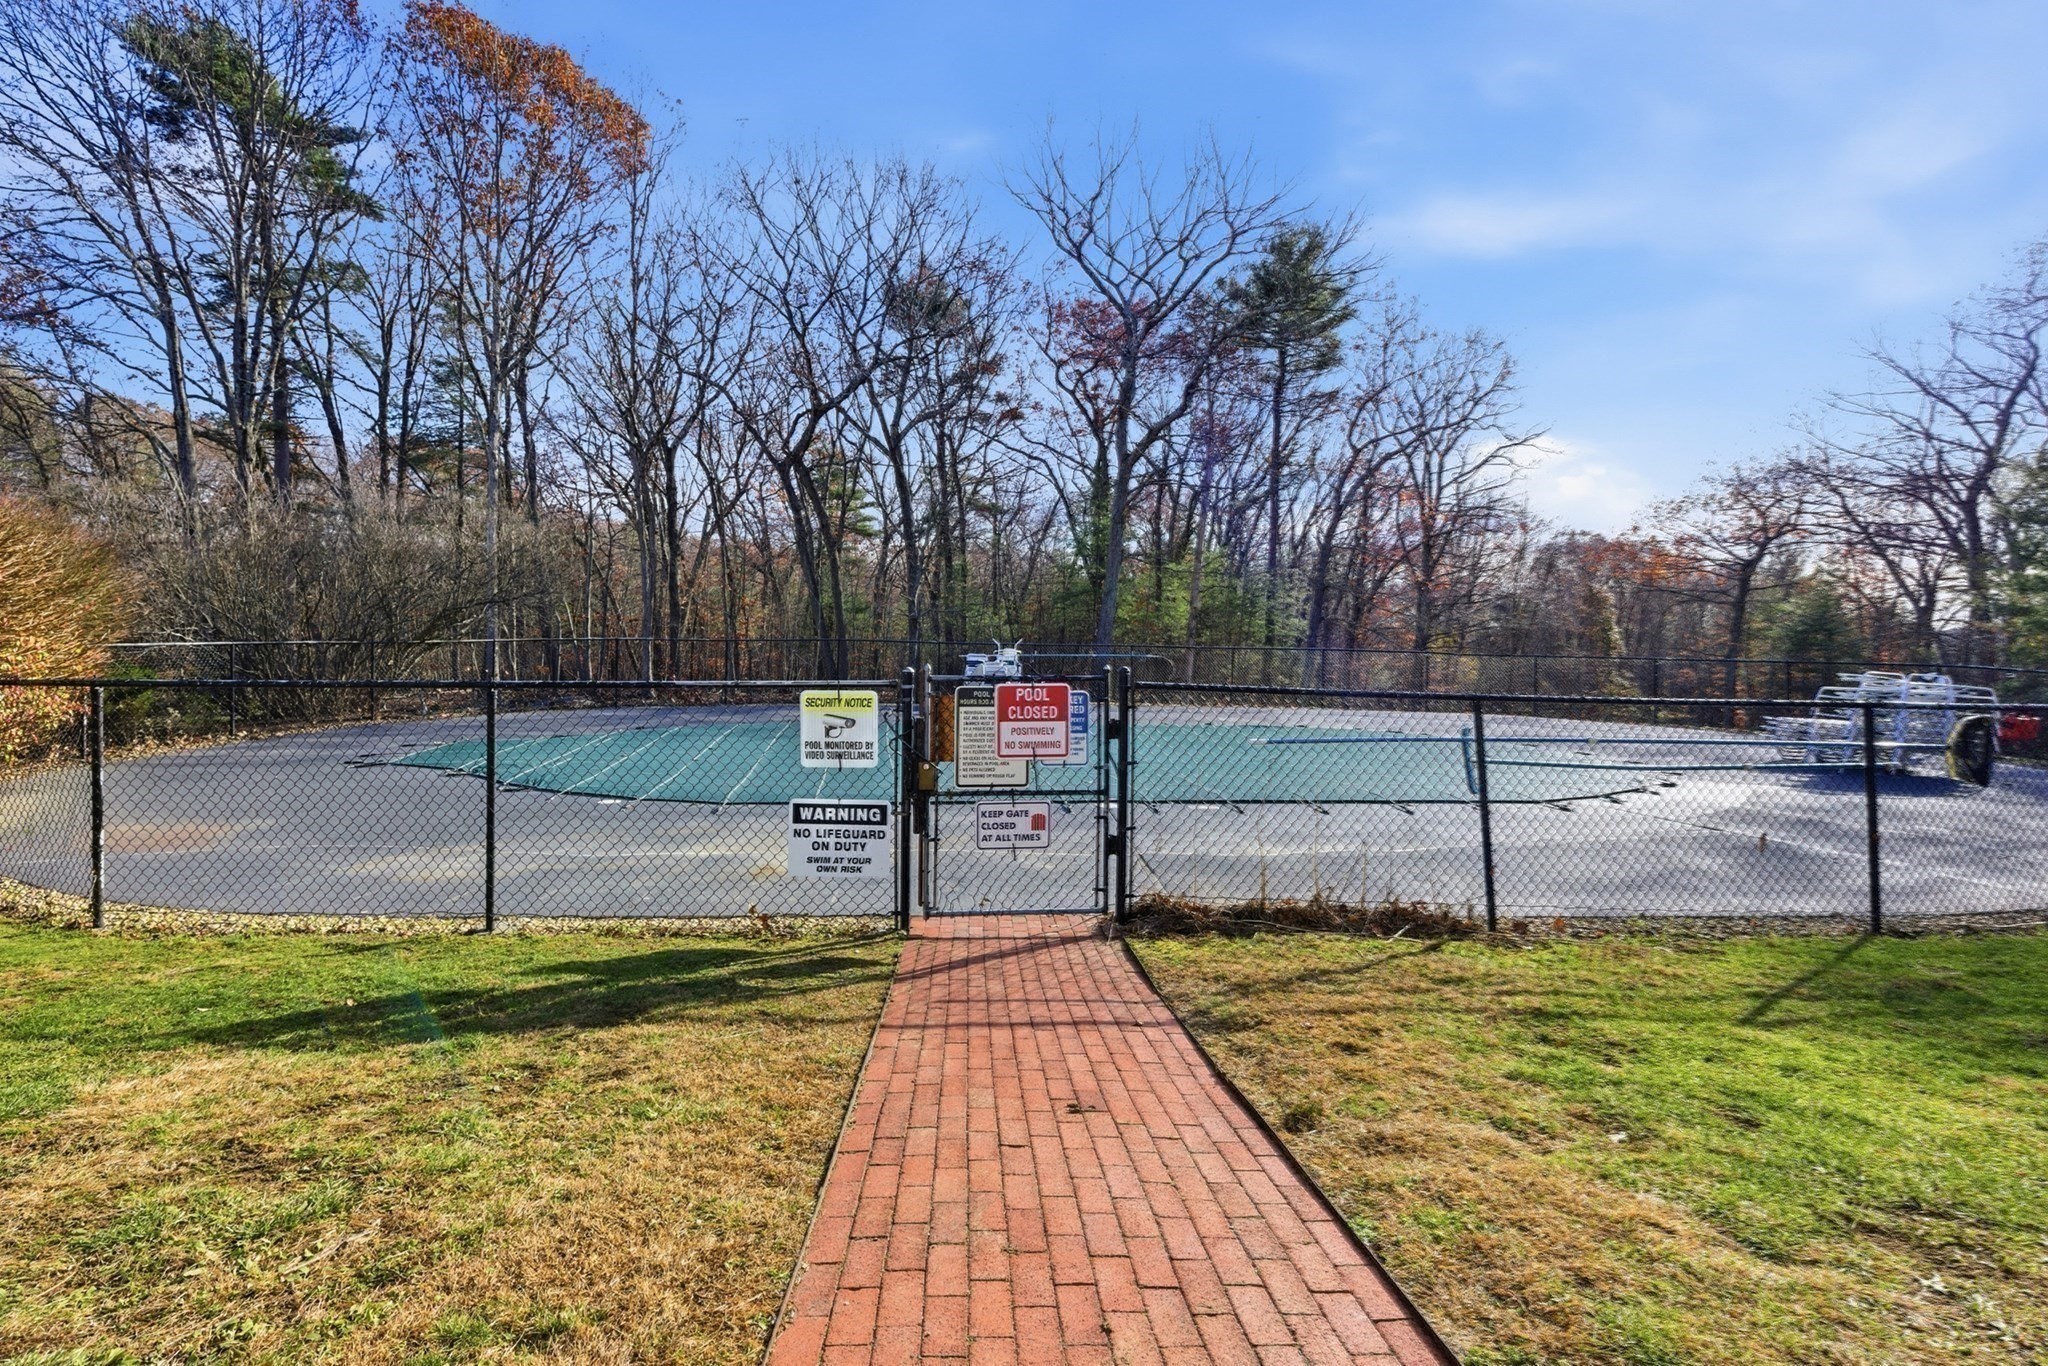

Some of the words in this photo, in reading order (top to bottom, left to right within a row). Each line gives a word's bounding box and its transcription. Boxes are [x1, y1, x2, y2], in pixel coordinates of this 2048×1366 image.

[1016, 688, 1049, 702] POOL
[805, 697, 842, 708] SECURITY
[844, 697, 872, 708] NOTICE
[1008, 705, 1058, 719] CLOSED
[1070, 705, 1084, 714] RED
[1011, 727, 1055, 736] POSITIVELY
[805, 741, 822, 750] POOL
[825, 741, 863, 750] MONITORED
[865, 741, 874, 750] BY
[1004, 740, 1016, 750] NO
[1018, 740, 1062, 750] SWIMMING
[805, 751, 824, 760] VIDEO
[827, 751, 874, 760] SURVEILLANCE
[800, 807, 881, 822] WARNING
[981, 810, 1004, 818] KEEP
[1006, 810, 1029, 818] GATE
[793, 829, 811, 839] NO
[816, 829, 886, 840] LIFEGUARD
[981, 833, 992, 842] AT
[995, 833, 1011, 842] ALL
[1013, 833, 1040, 842] TIMES
[811, 841, 829, 852] ON
[834, 841, 867, 852] DUTY
[816, 865, 837, 873] OWN
[840, 865, 862, 873] RISK
